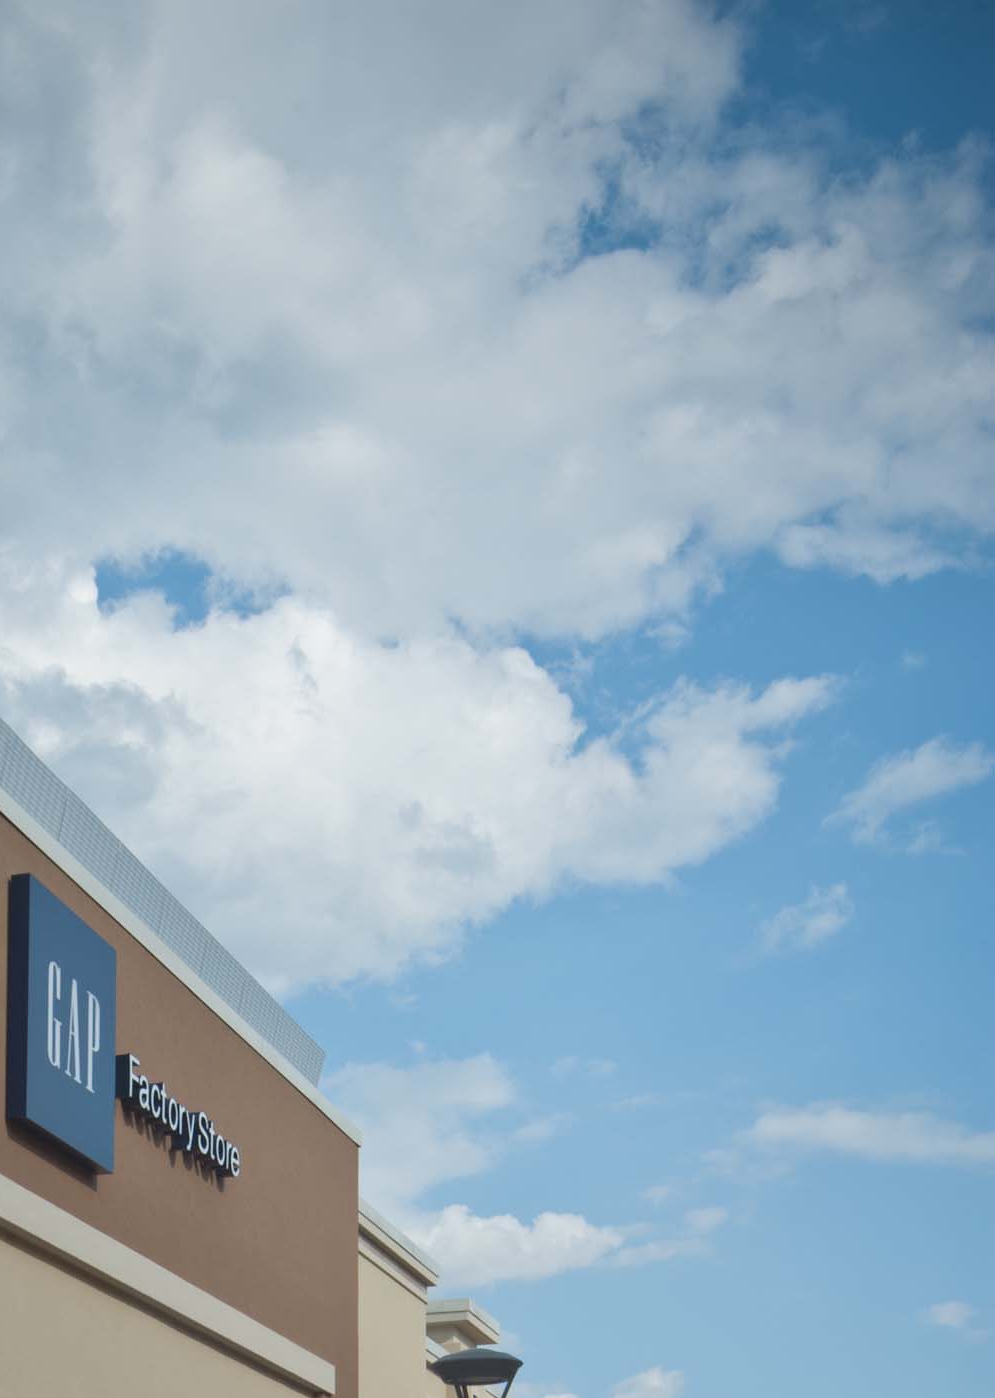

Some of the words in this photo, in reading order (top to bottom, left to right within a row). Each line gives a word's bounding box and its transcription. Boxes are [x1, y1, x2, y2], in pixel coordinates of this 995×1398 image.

[47, 961, 100, 1093] GAP
[129, 1054, 196, 1151] Factory
[198, 1111, 240, 1177] Store
